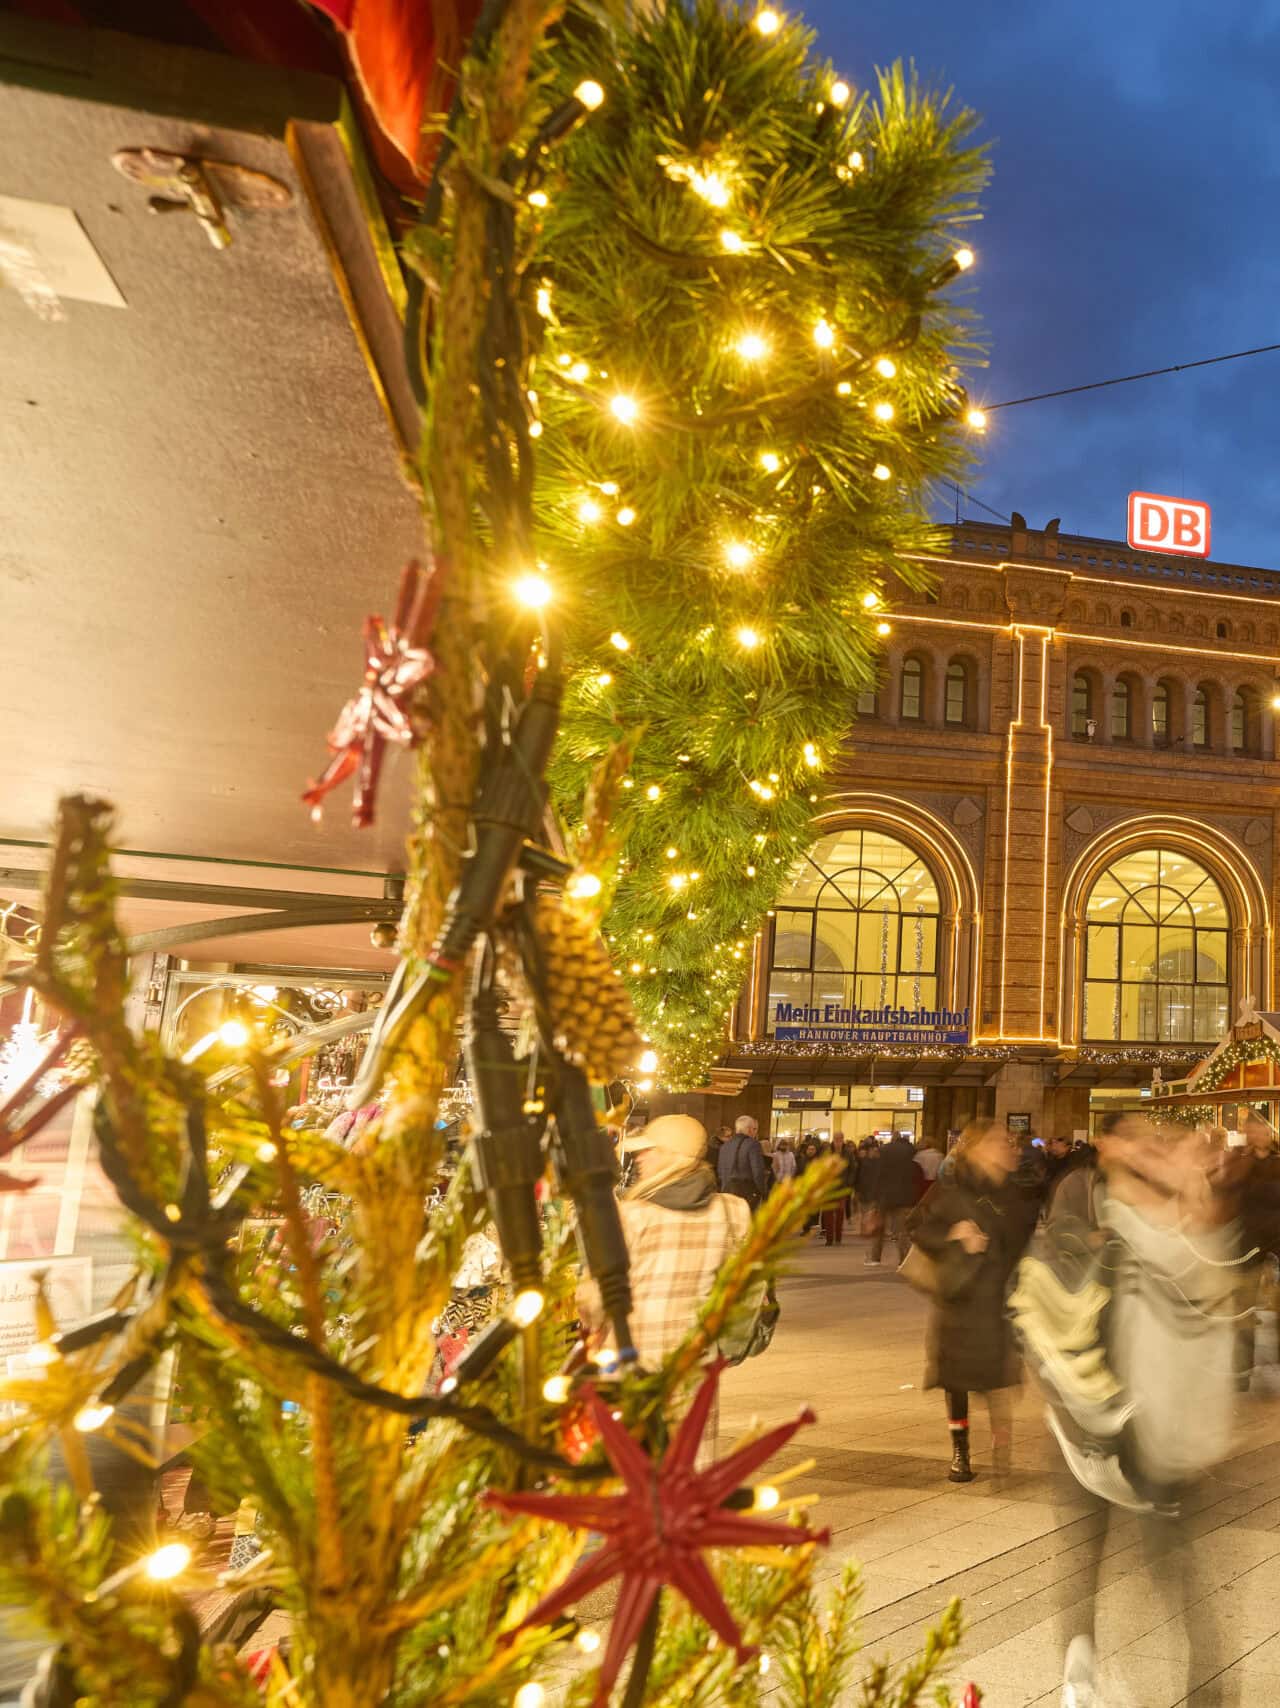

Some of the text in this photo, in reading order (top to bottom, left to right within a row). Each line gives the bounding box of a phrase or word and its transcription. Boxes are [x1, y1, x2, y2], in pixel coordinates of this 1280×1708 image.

[1140, 503, 1201, 547] DB
[776, 1003, 970, 1026] Mein Einkaufsbahnhof
[799, 1030, 948, 1043] HANNOVER HAUPTBAHNHOF
